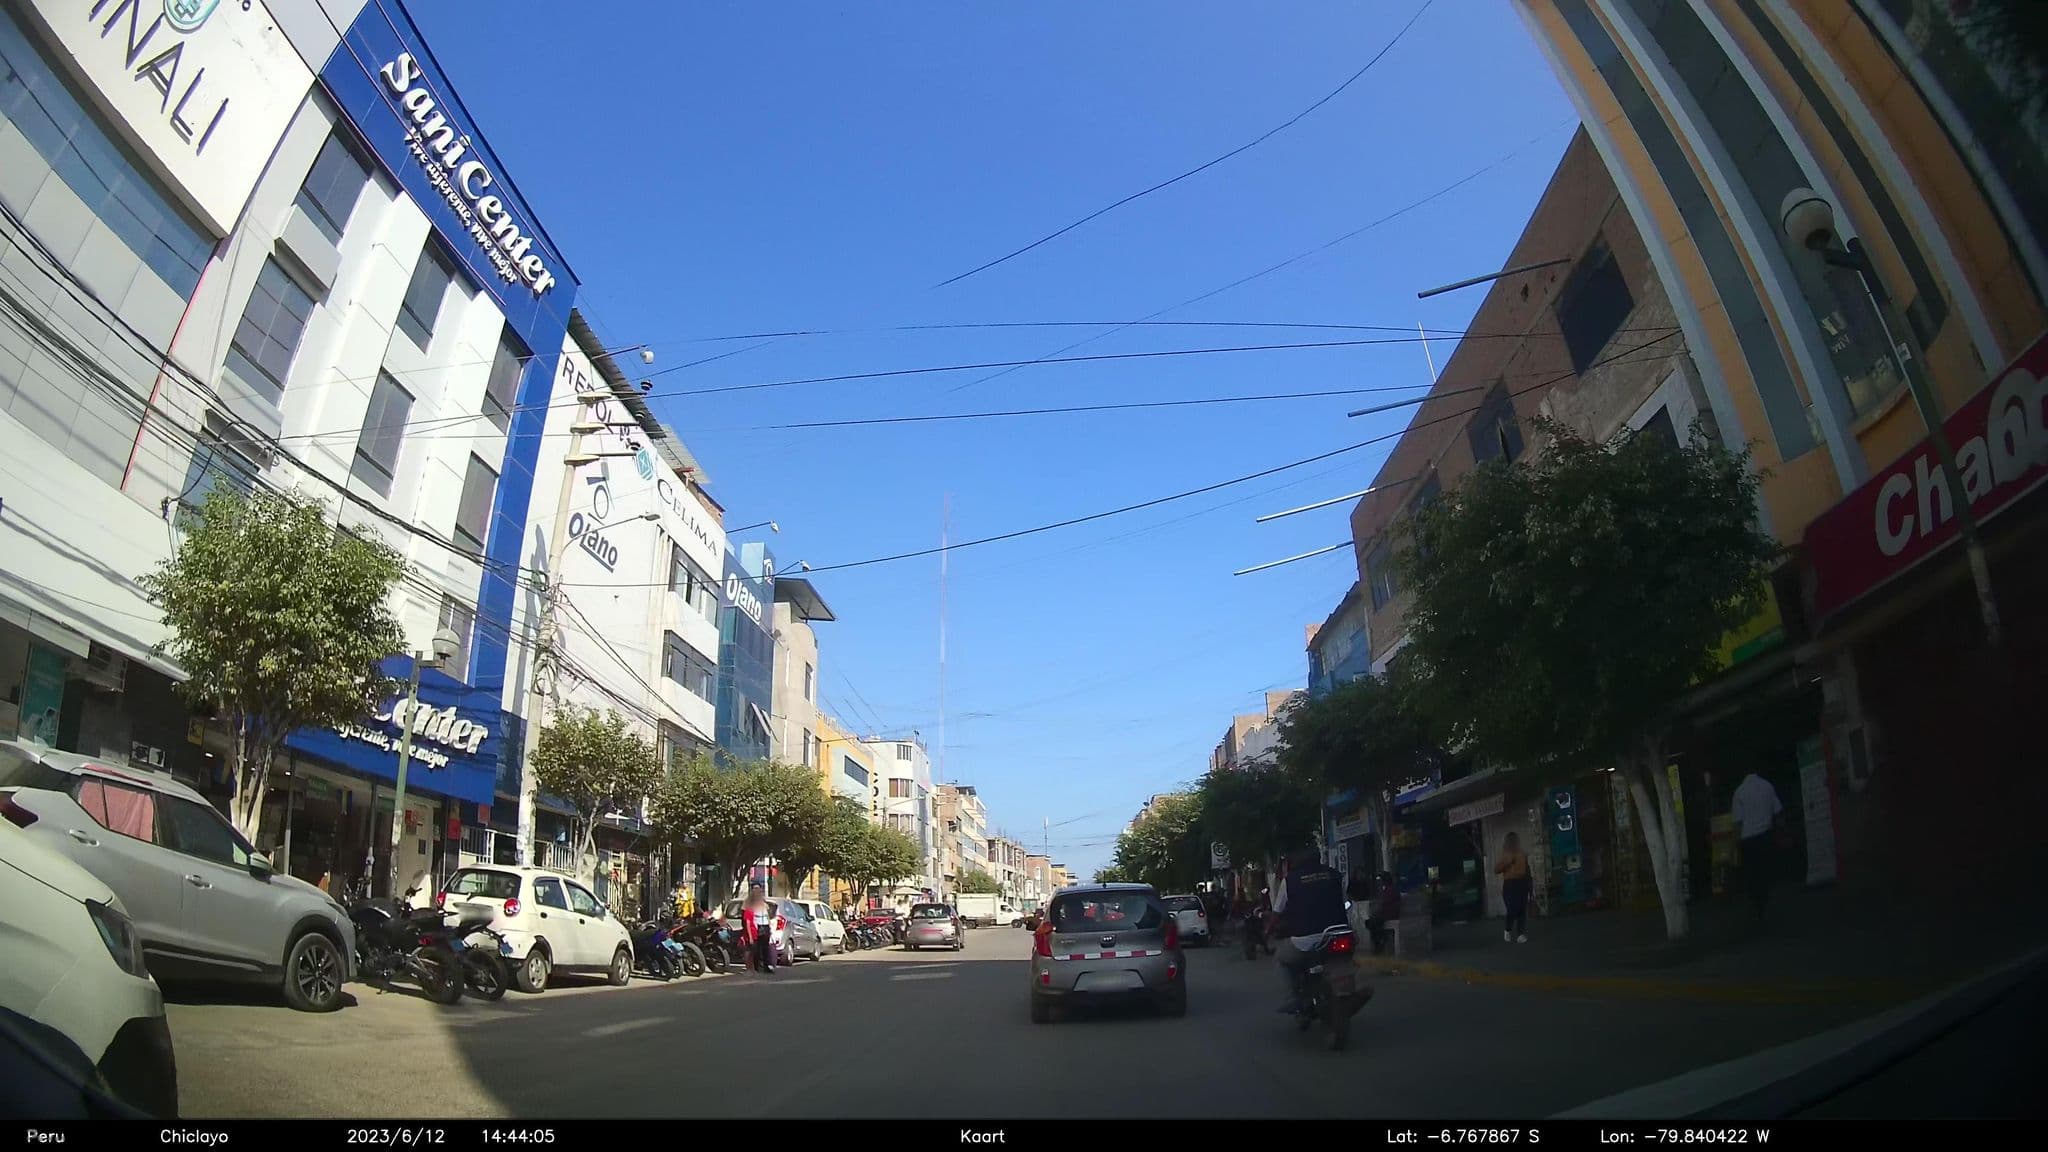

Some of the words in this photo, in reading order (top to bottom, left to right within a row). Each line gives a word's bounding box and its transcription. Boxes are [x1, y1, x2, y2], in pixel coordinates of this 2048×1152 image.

[471, 222, 493, 250] vive
[491, 248, 518, 283] mejor
[568, 512, 618, 568] Olano
[657, 478, 718, 556] CELIMA
[726, 572, 762, 622] Olano
